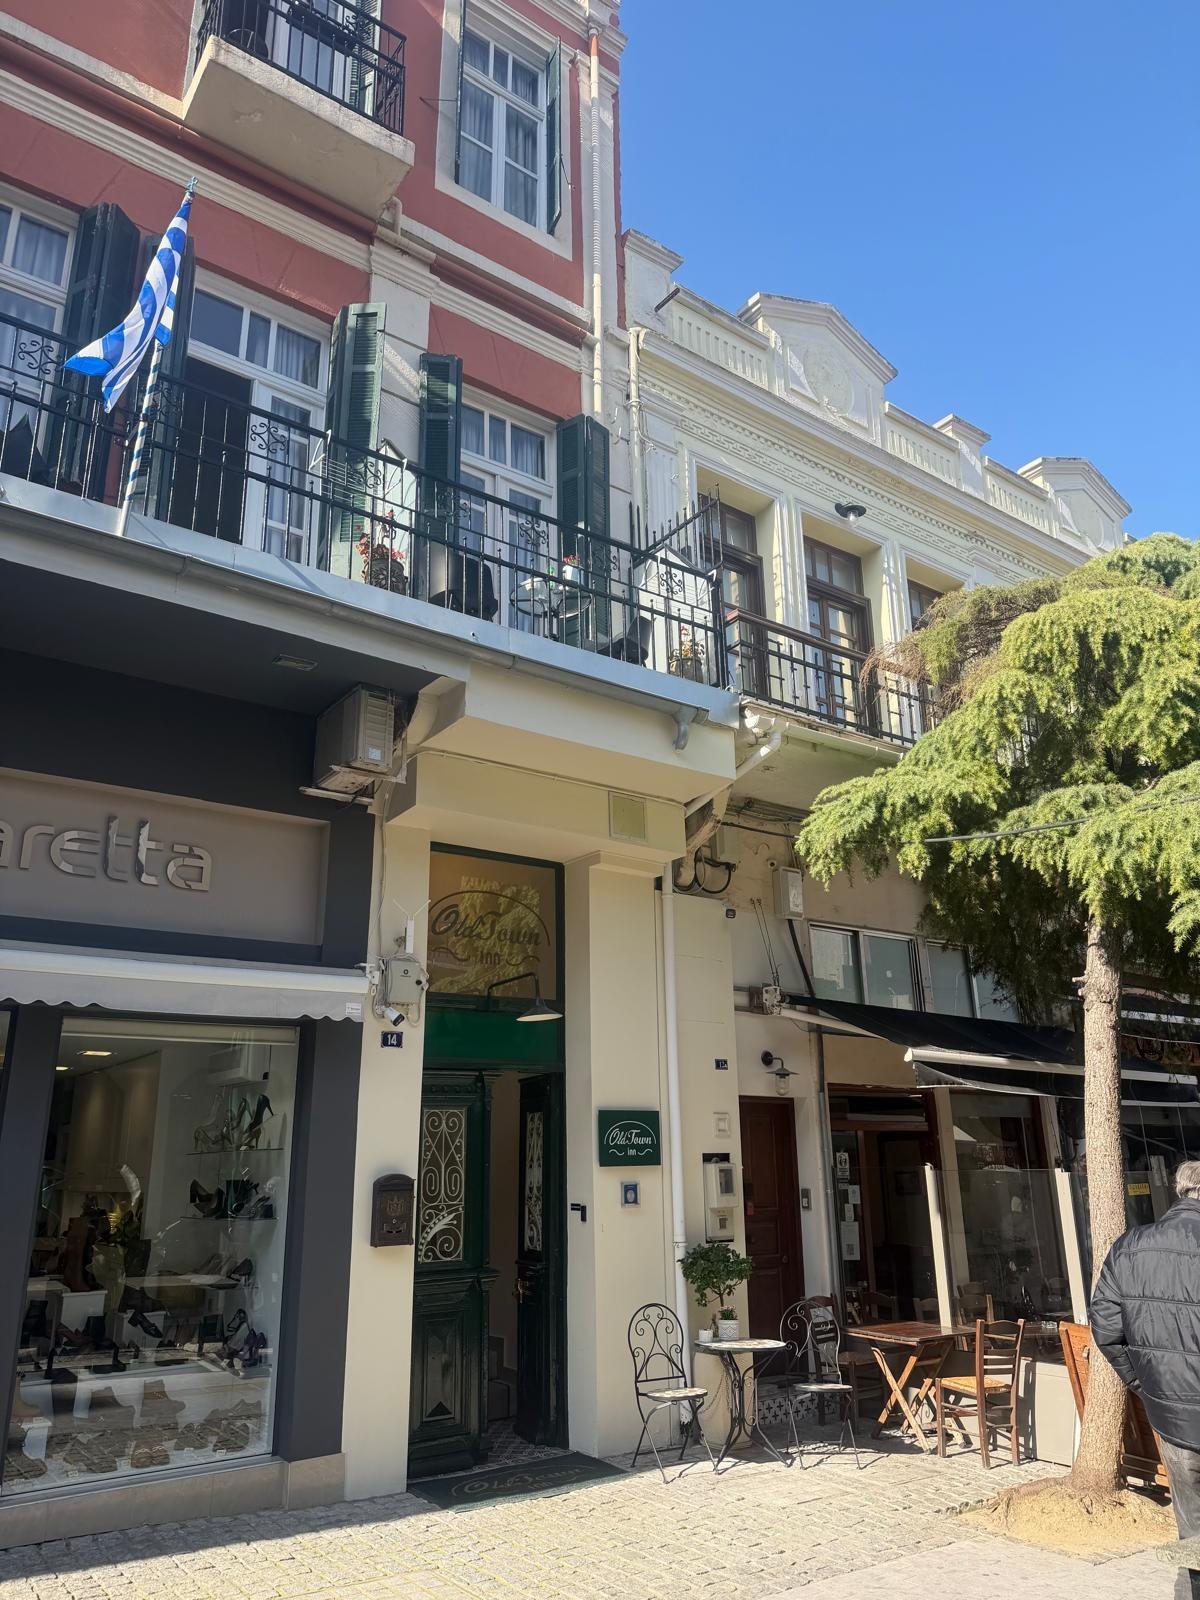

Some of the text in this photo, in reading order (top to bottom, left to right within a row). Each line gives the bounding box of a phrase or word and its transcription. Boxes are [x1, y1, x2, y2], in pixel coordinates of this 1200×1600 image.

[431, 904, 541, 945] Old Town
[387, 1033, 398, 1046] 14
[608, 1128, 652, 1145] Old Town
